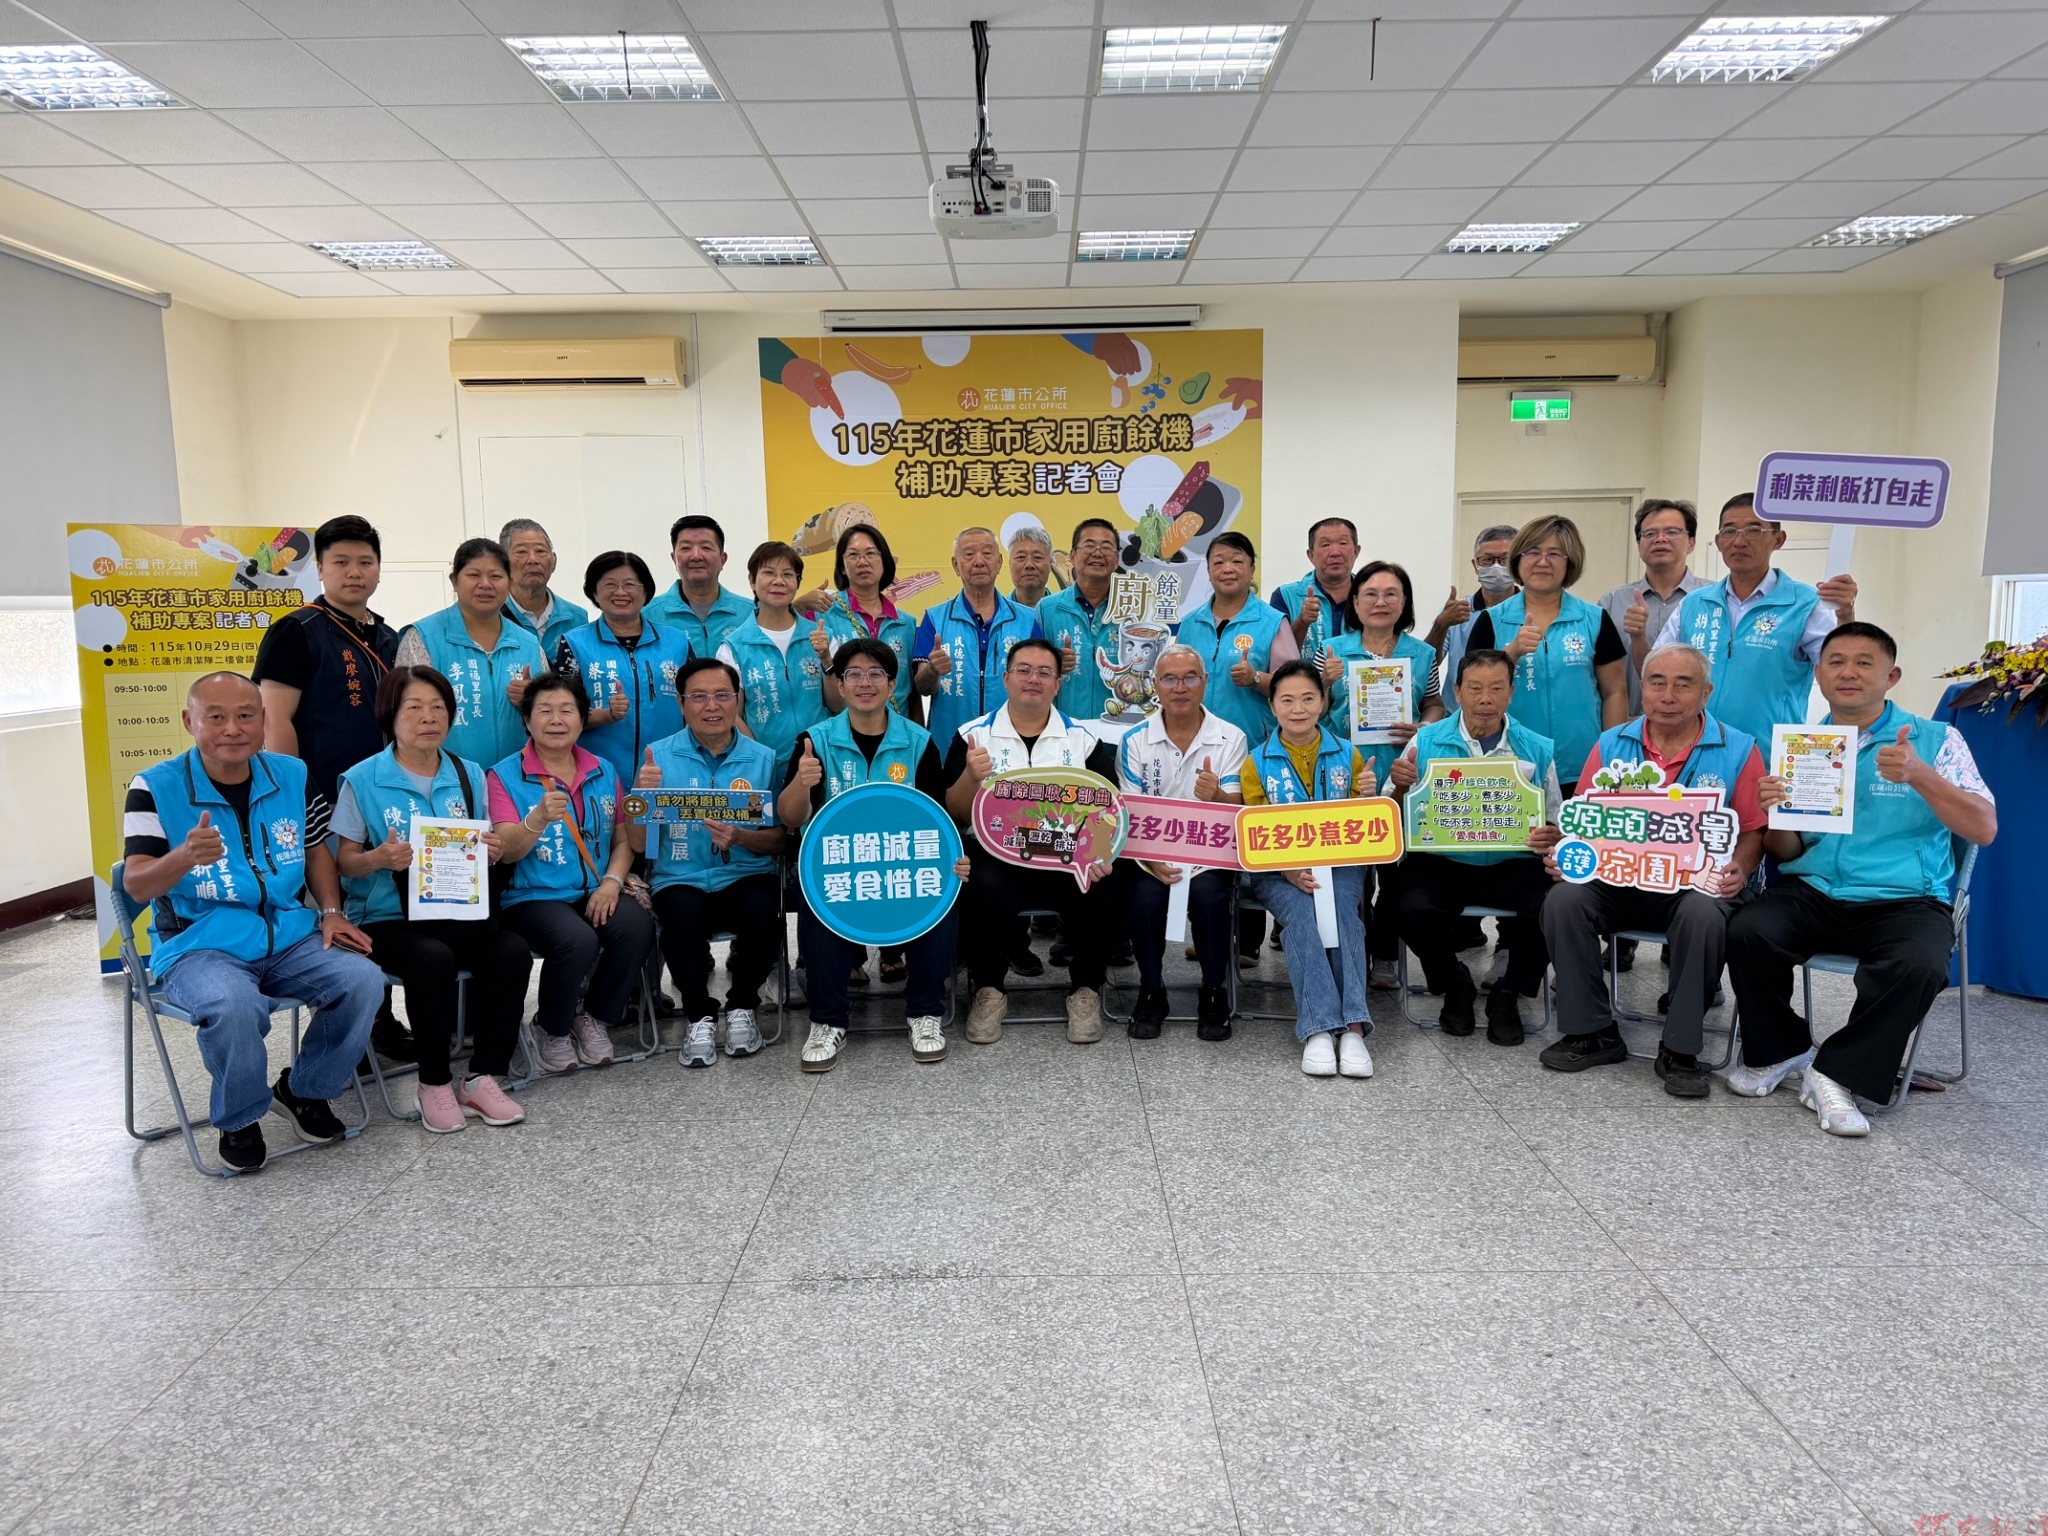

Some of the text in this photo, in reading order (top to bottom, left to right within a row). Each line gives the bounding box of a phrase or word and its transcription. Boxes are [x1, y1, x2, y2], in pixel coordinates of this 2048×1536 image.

[983, 386, 1068, 402] 花蓮市公所
[983, 402, 1068, 411] HUALIEN CITY OFFICE
[832, 414, 1194, 457] 115年花蓮市家用廚餘機
[1768, 472, 1935, 508] 剩菜剩飯打包走
[120, 558, 198, 571] 花蓮市公所
[90, 588, 305, 609] 115年花蓮市家用廚餘機
[114, 684, 168, 694] 09:50-10:00
[467, 659, 483, 718] 國福里里長
[117, 716, 170, 726] 10:00-10:05
[119, 748, 173, 758] 10:05-10:15
[655, 794, 729, 808] 請勿將廚餘
[994, 780, 1112, 807] 廚餘回收3部曲
[679, 808, 750, 821] 丟置垃圾桶
[1248, 816, 1390, 852] 吃多少煮多少
[1561, 801, 1733, 854] 源頭減量
[822, 829, 941, 866] 廚餘減量
[823, 866, 943, 903] 愛食惜食
